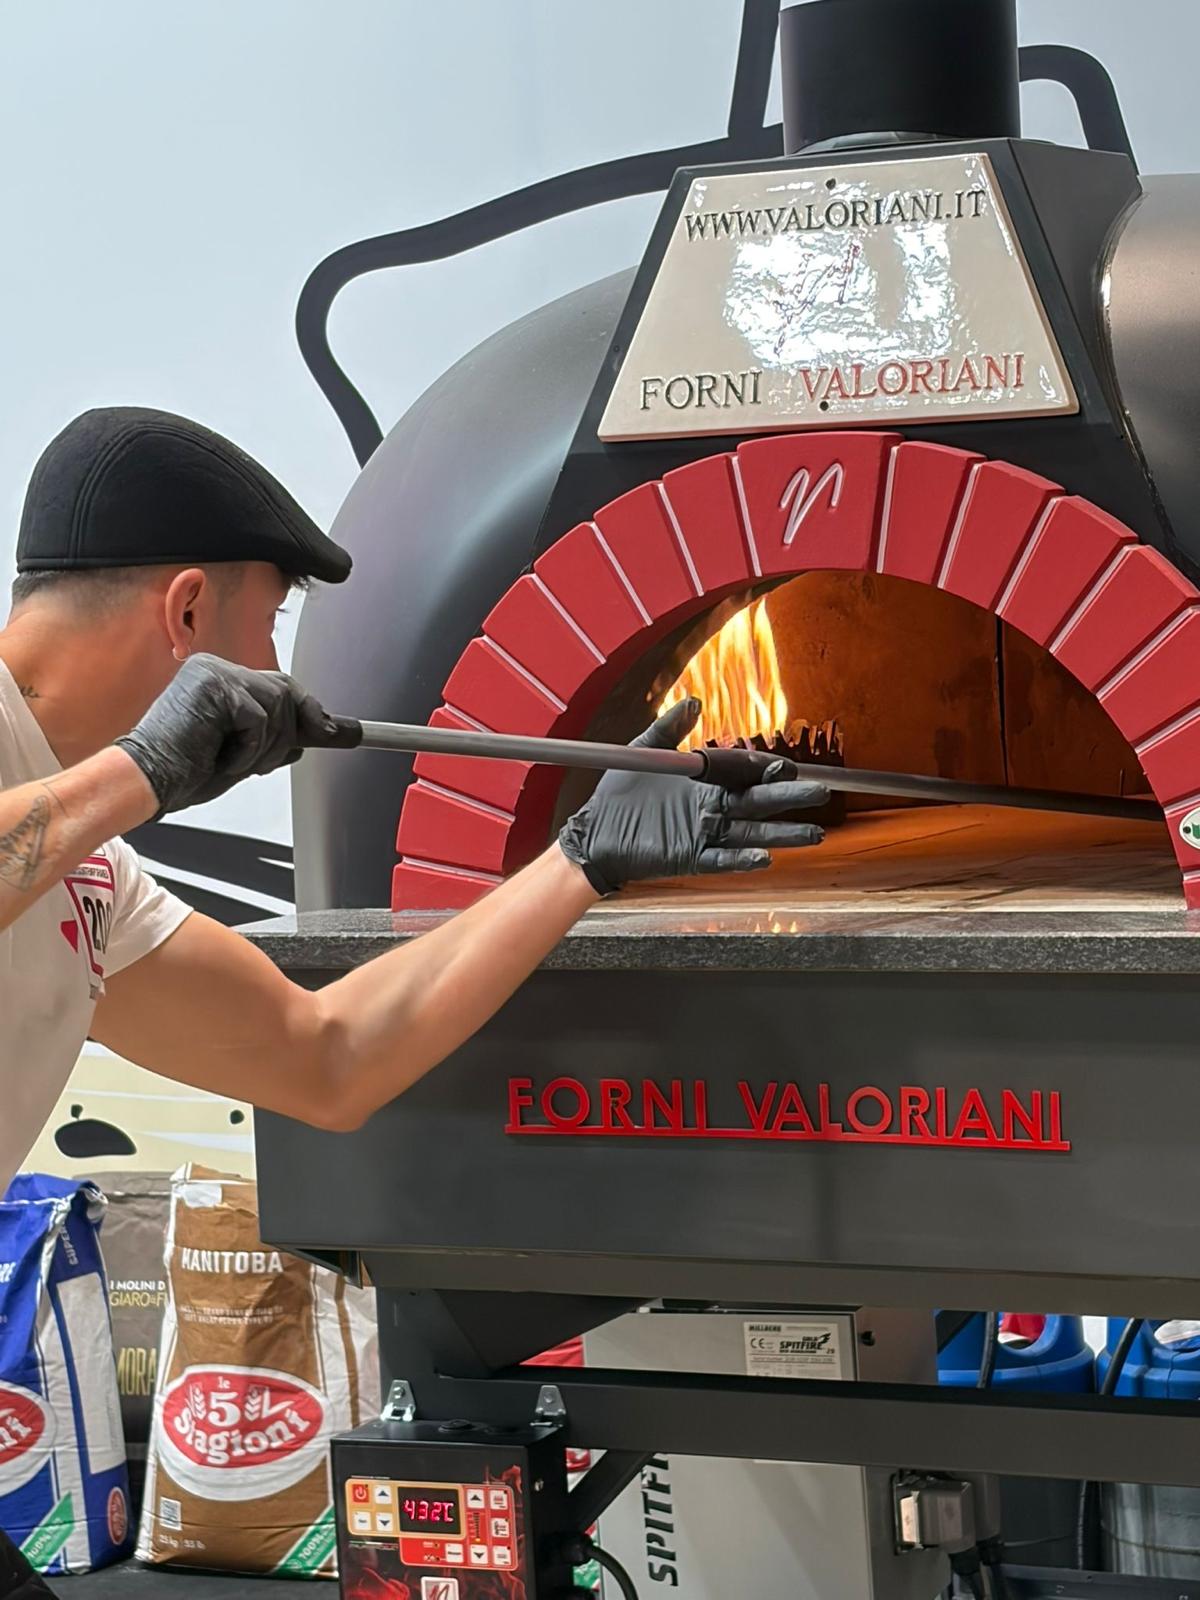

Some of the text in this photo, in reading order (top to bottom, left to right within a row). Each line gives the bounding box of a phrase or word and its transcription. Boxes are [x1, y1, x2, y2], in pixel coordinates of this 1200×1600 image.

[684, 190, 987, 242] WWW.VALORIANI.IT
[640, 353, 1025, 410] FORNI VALORIANI
[507, 1077, 1064, 1145] FORNI VALORIANI
[182, 1247, 283, 1274] MANITOBA
[116, 1280, 156, 1291] MOLINI
[157, 1280, 166, 1291] D
[780, 1341, 823, 1351] SPITFIRE
[217, 1376, 231, 1389] le
[208, 1391, 241, 1427] 5
[174, 1407, 310, 1465] Stagioni
